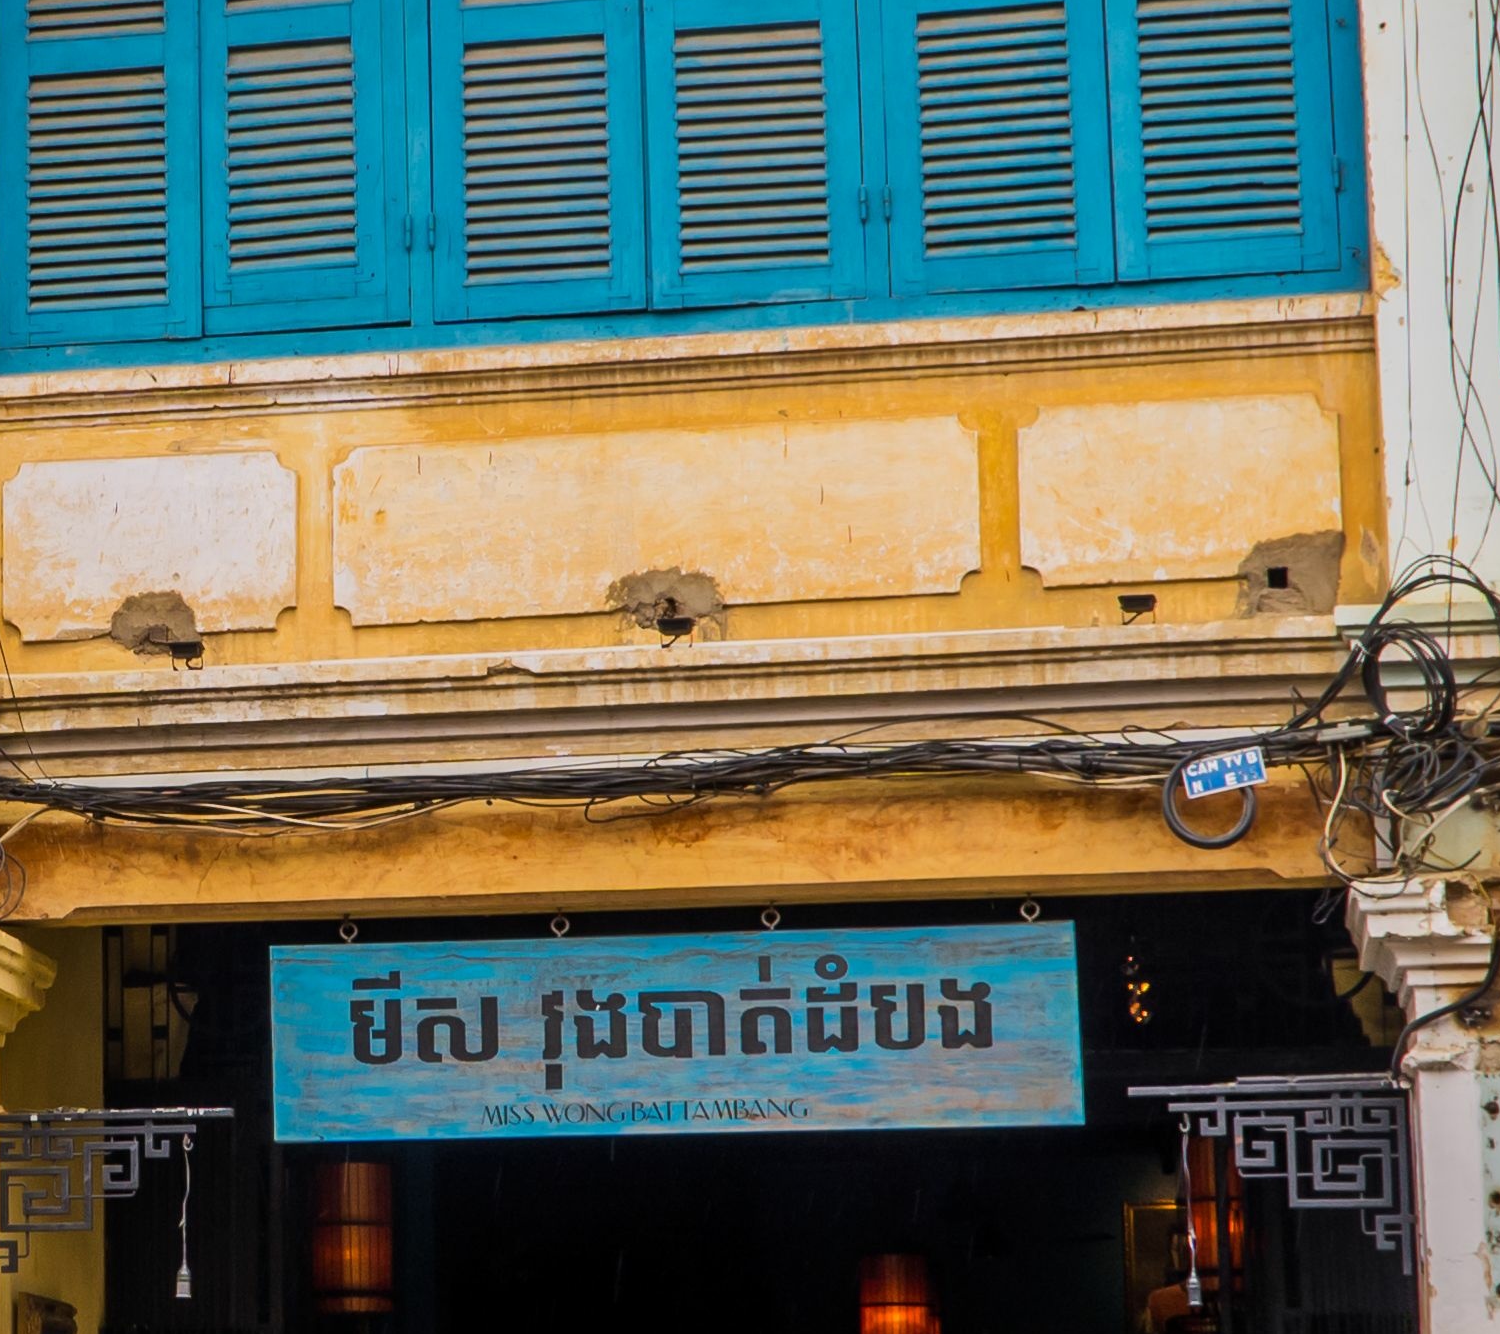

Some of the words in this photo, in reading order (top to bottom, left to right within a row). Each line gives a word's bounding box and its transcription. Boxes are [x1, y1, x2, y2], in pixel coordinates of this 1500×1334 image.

[1222, 754, 1243, 769] TV
[1246, 751, 1258, 765] B
[350, 971, 499, 1064] មីស
[482, 1104, 536, 1126] MISS
[542, 1102, 626, 1124] WONG
[631, 1098, 808, 1122] BATTAMBANG
